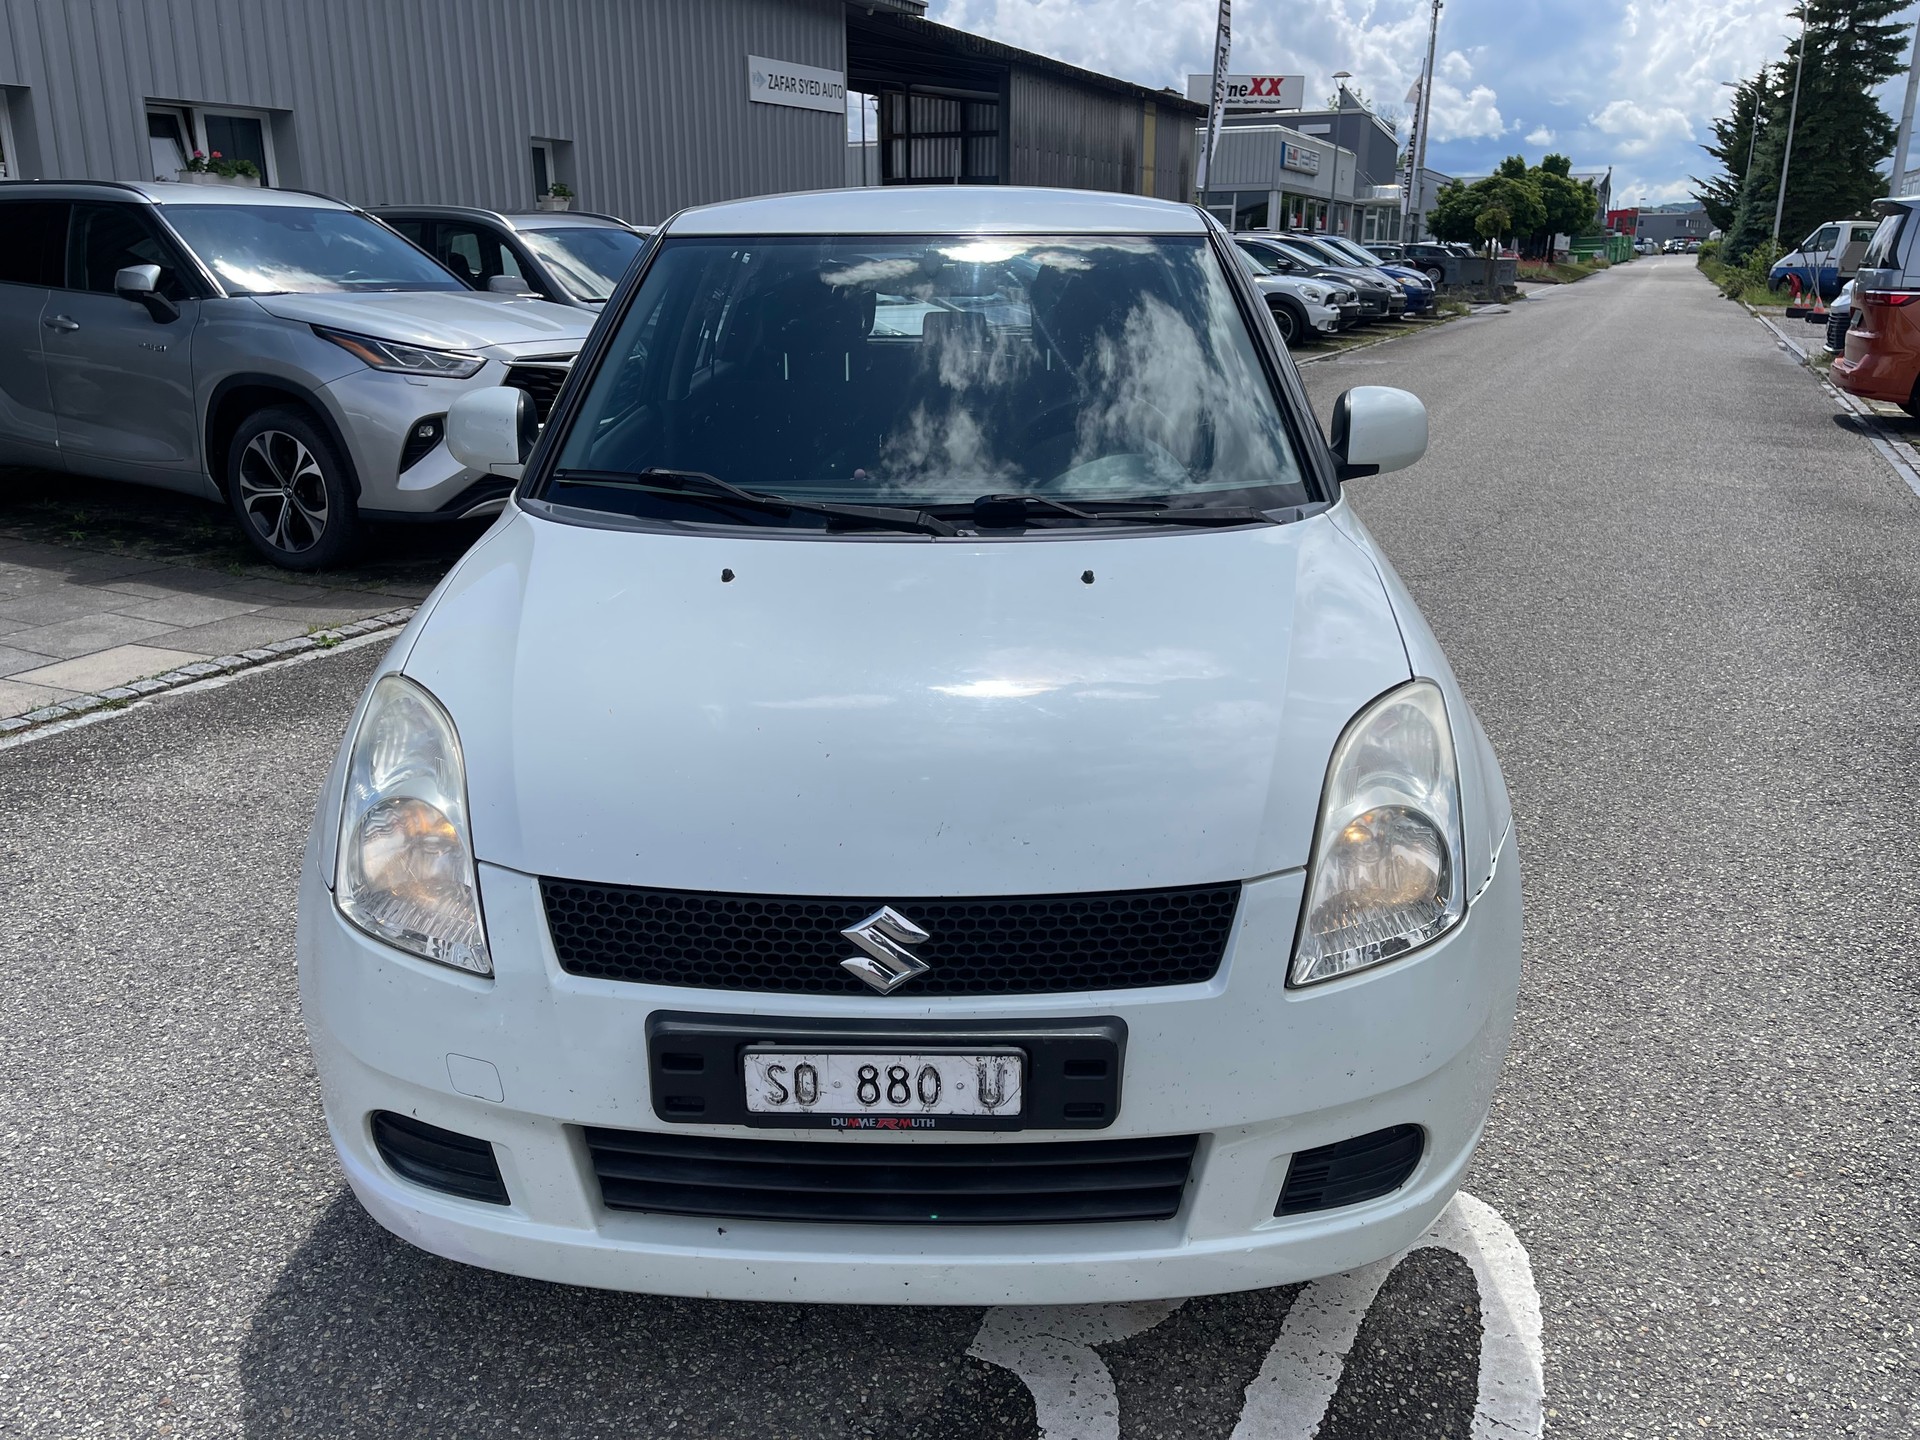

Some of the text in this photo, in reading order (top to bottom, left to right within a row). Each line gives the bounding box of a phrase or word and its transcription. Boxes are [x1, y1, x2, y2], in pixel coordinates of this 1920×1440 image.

[768, 74, 843, 99] ZAFAR SYED AUTO
[1227, 78, 1284, 97] neXX
[766, 1062, 1005, 1106] SO 880 U
